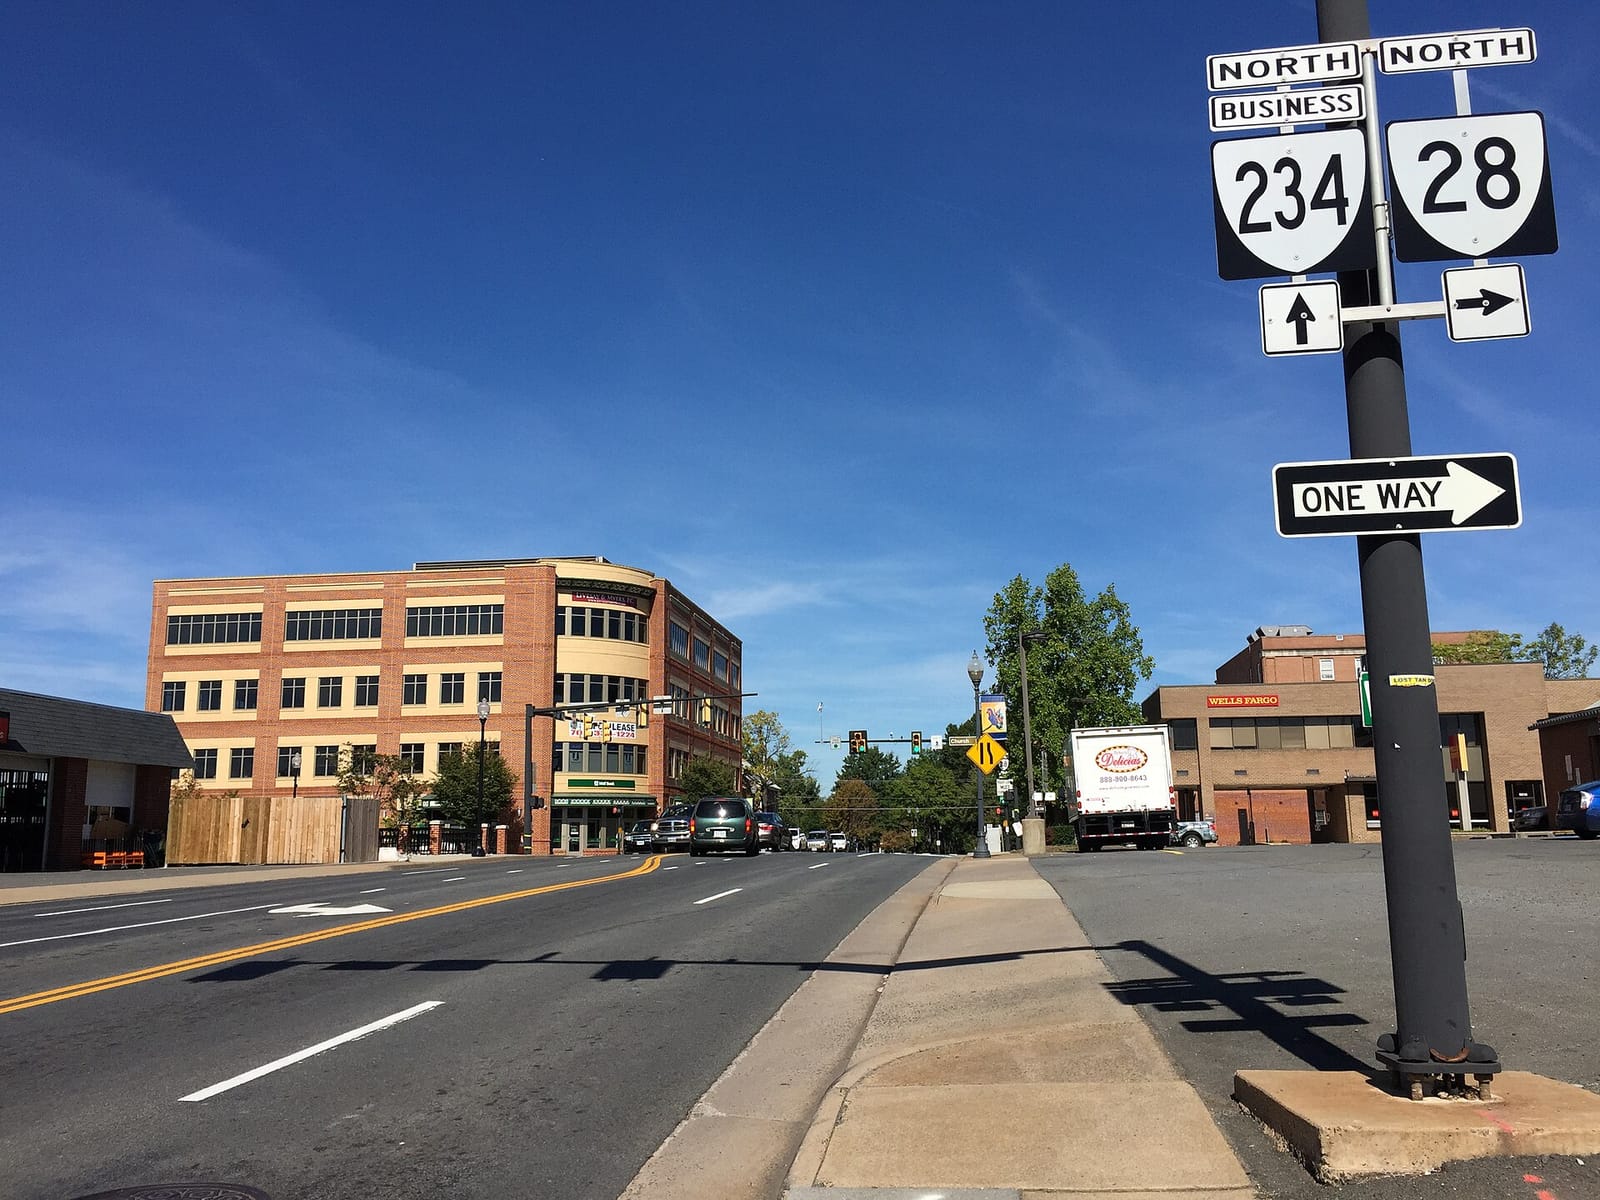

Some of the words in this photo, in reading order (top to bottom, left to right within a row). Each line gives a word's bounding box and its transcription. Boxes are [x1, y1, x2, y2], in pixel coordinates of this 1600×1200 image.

[1219, 51, 1350, 81] NORTH
[1390, 36, 1524, 66] NORTH
[1221, 94, 1353, 121] BUSINESS
[1417, 136, 1521, 214] 28
[1235, 153, 1349, 235] 234
[1302, 484, 1366, 513] ONE
[1377, 480, 1443, 509] WAY
[1208, 696, 1243, 705] WELLS
[1244, 696, 1278, 704] FARGO
[611, 722, 635, 732] LEASE
[1101, 752, 1142, 767] Delicias
